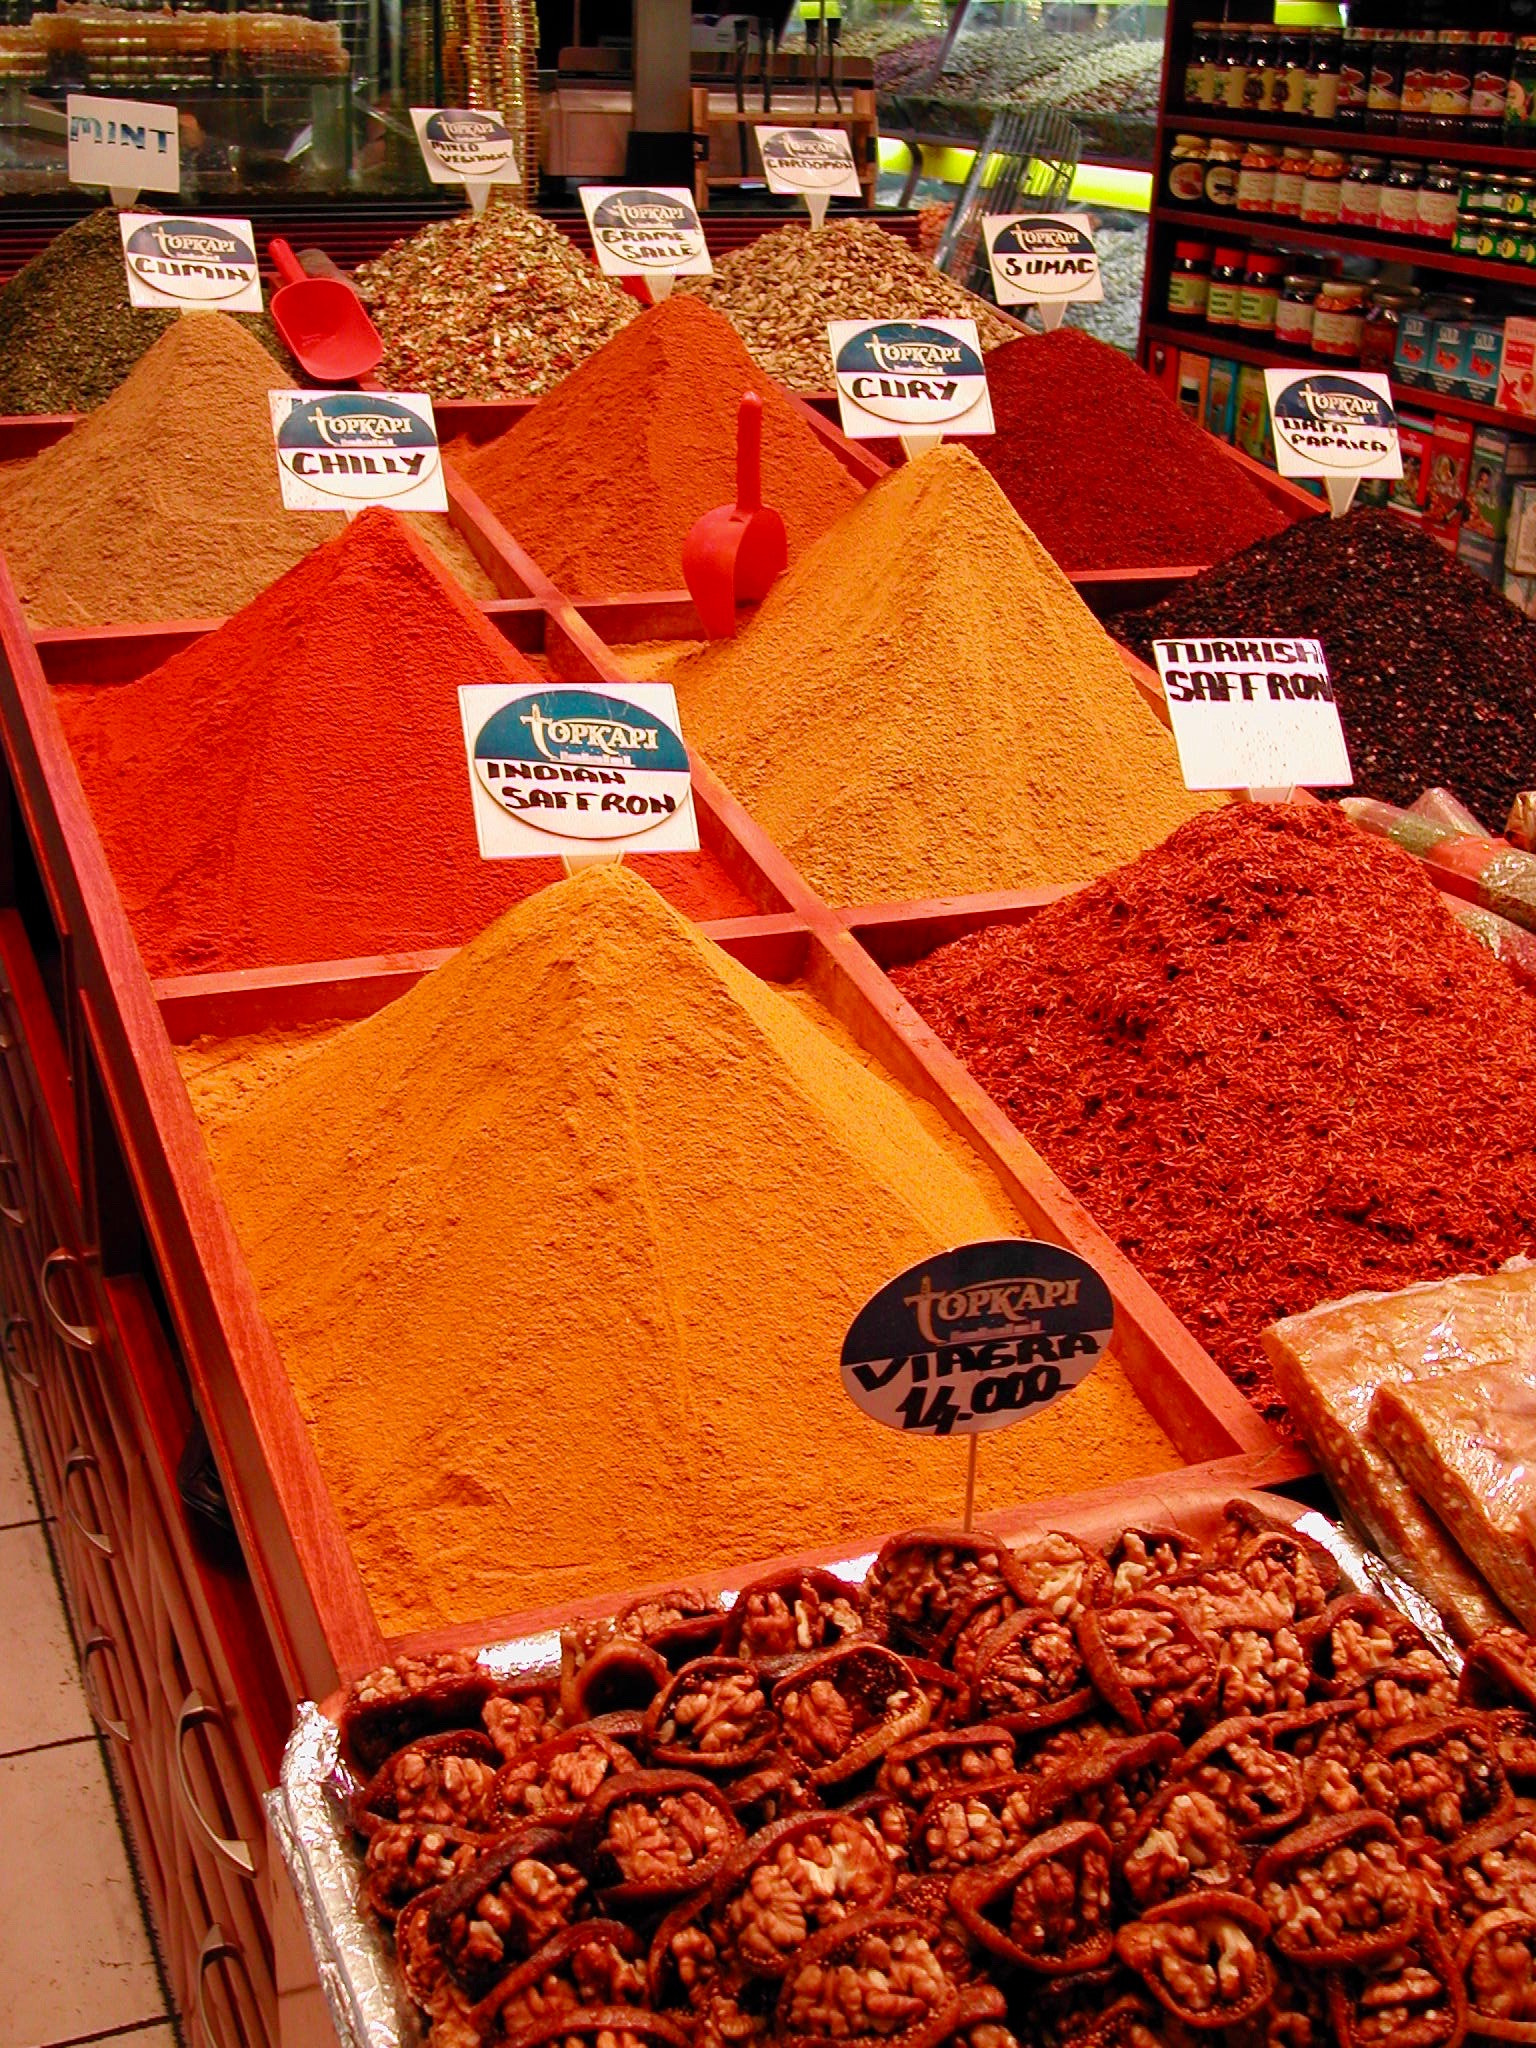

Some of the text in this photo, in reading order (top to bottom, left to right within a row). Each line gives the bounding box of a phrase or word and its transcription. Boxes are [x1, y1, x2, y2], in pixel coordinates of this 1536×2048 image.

[70, 116, 175, 154] MINT
[431, 141, 479, 152] MIXED
[152, 225, 237, 258] TOPKAPI
[1009, 223, 1081, 253] TOPKAPI
[135, 257, 250, 282] CUMIN
[1005, 257, 1095, 276] SUMAC
[864, 333, 962, 372] TOPKAPI
[852, 377, 958, 401] CURY
[1298, 383, 1379, 422] TOPKAPI
[307, 406, 413, 447] TOPKAPI
[1282, 419, 1348, 434] URFA
[292, 452, 425, 476] CHILLY
[1156, 641, 1325, 664] TURKISH
[1165, 670, 1335, 703] SAFFRON
[520, 703, 658, 762] TOPKAPI
[487, 761, 626, 785] INDIAN
[501, 786, 677, 815] SAFFRON
[903, 1274, 1081, 1346] TOPKAPI
[851, 1333, 1100, 1392] VIAGRA
